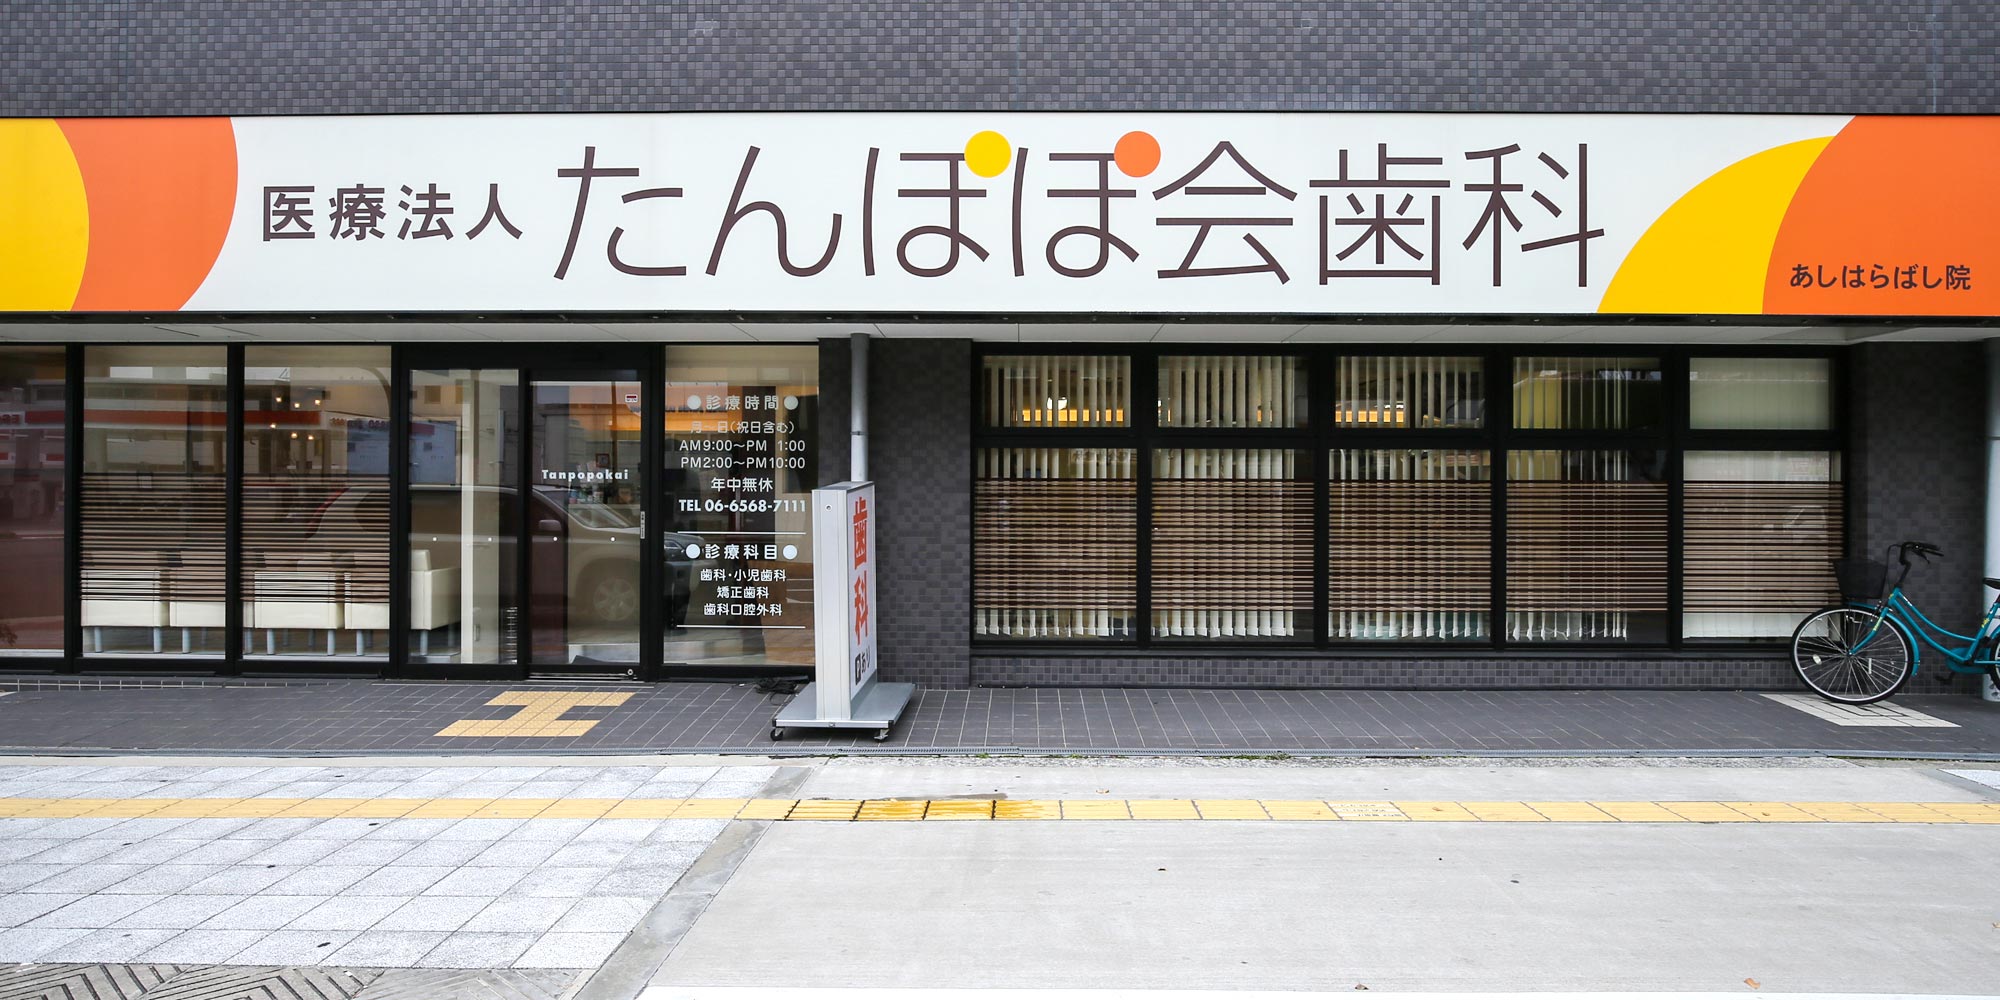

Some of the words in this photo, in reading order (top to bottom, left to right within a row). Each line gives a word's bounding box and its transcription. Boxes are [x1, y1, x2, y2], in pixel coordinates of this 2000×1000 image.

[263, 183, 522, 242] 医療法人
[554, 131, 1605, 287] たんぽぽ会歯科
[1789, 263, 1971, 290] あしはらばし院
[705, 394, 779, 411] 診療時間
[541, 469, 629, 482] Tanpopokai
[711, 477, 773, 492] 年中無休
[678, 499, 701, 512] TEL
[704, 498, 806, 512] 06-6568-7111
[704, 544, 777, 560] 診療科目
[853, 496, 868, 645] 歯科
[716, 586, 770, 599] 矯正歯科
[703, 603, 783, 616] 歯科口腔外科
